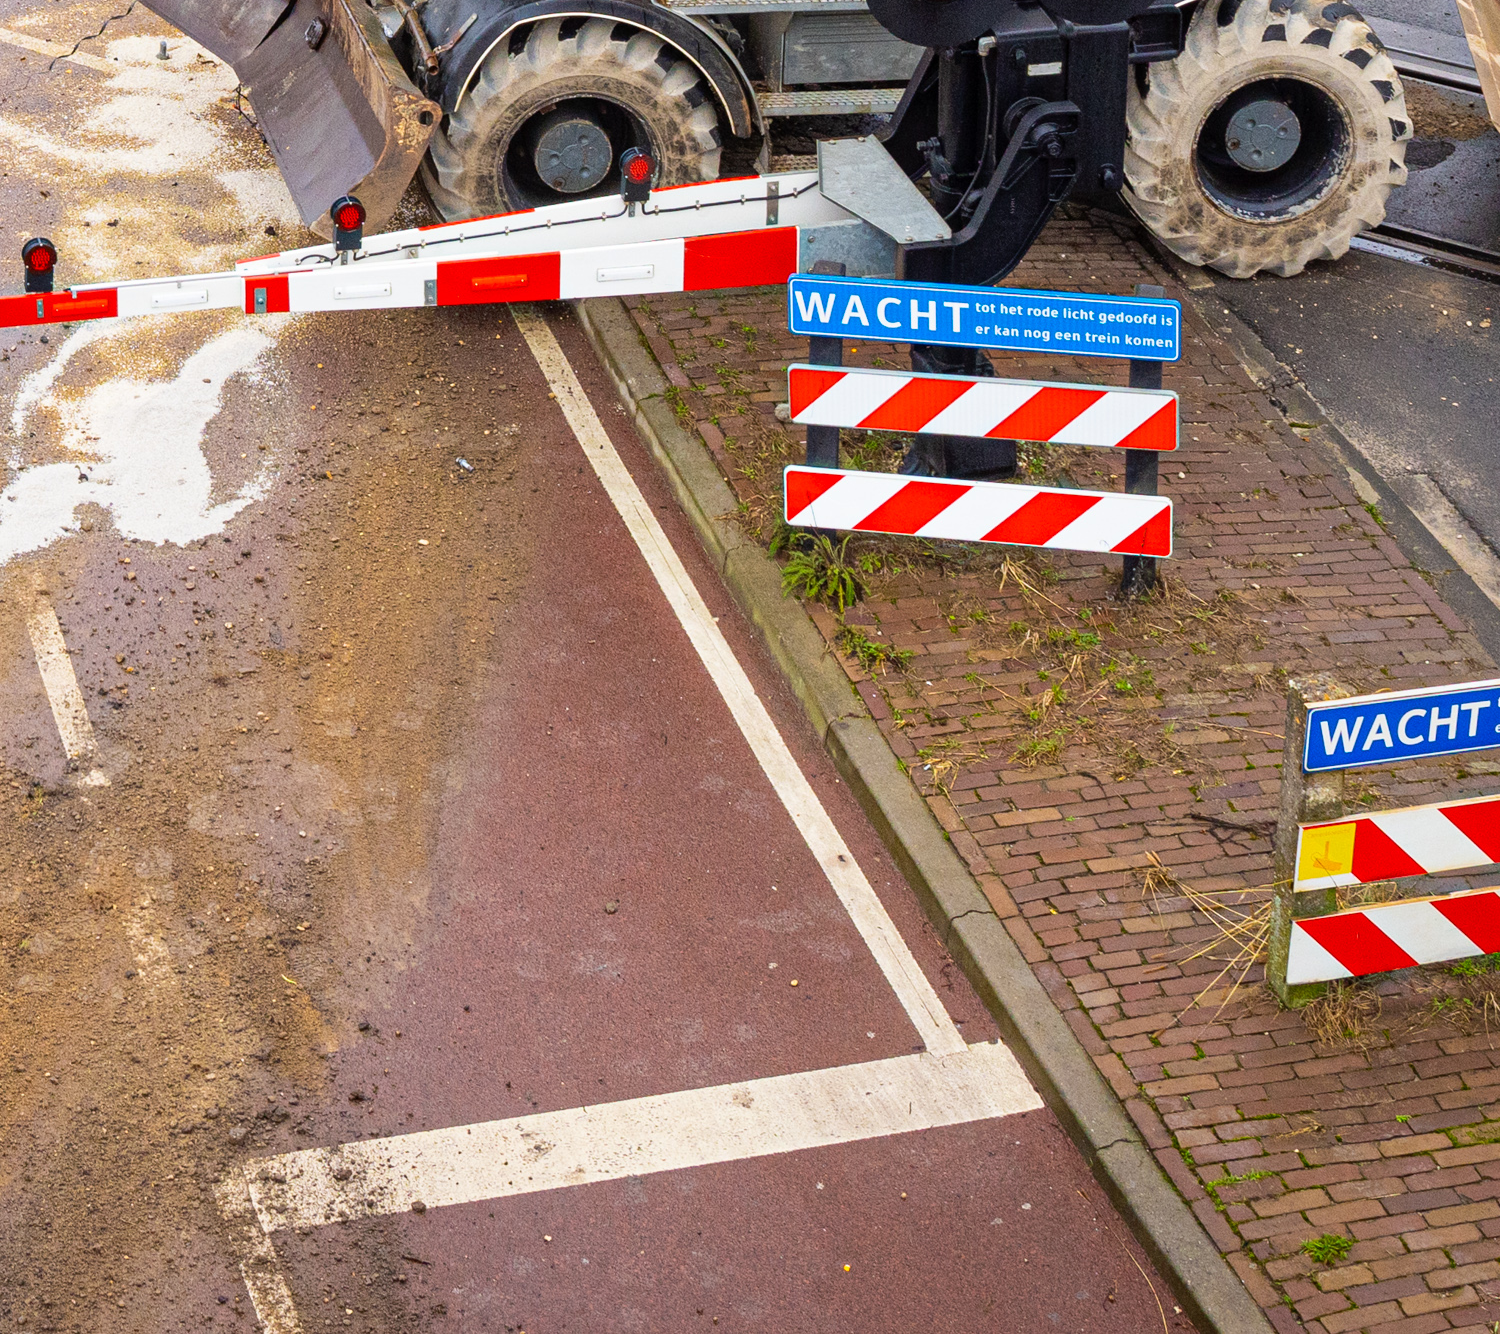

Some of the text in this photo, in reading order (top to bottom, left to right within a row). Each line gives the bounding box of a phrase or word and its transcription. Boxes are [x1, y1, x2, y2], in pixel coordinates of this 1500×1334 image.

[794, 290, 970, 333] WACHT
[975, 301, 1174, 327] tot het rode licht gedoofd is
[975, 324, 1174, 348] er kan nog een trein komen
[1319, 700, 1491, 756] WACHT
